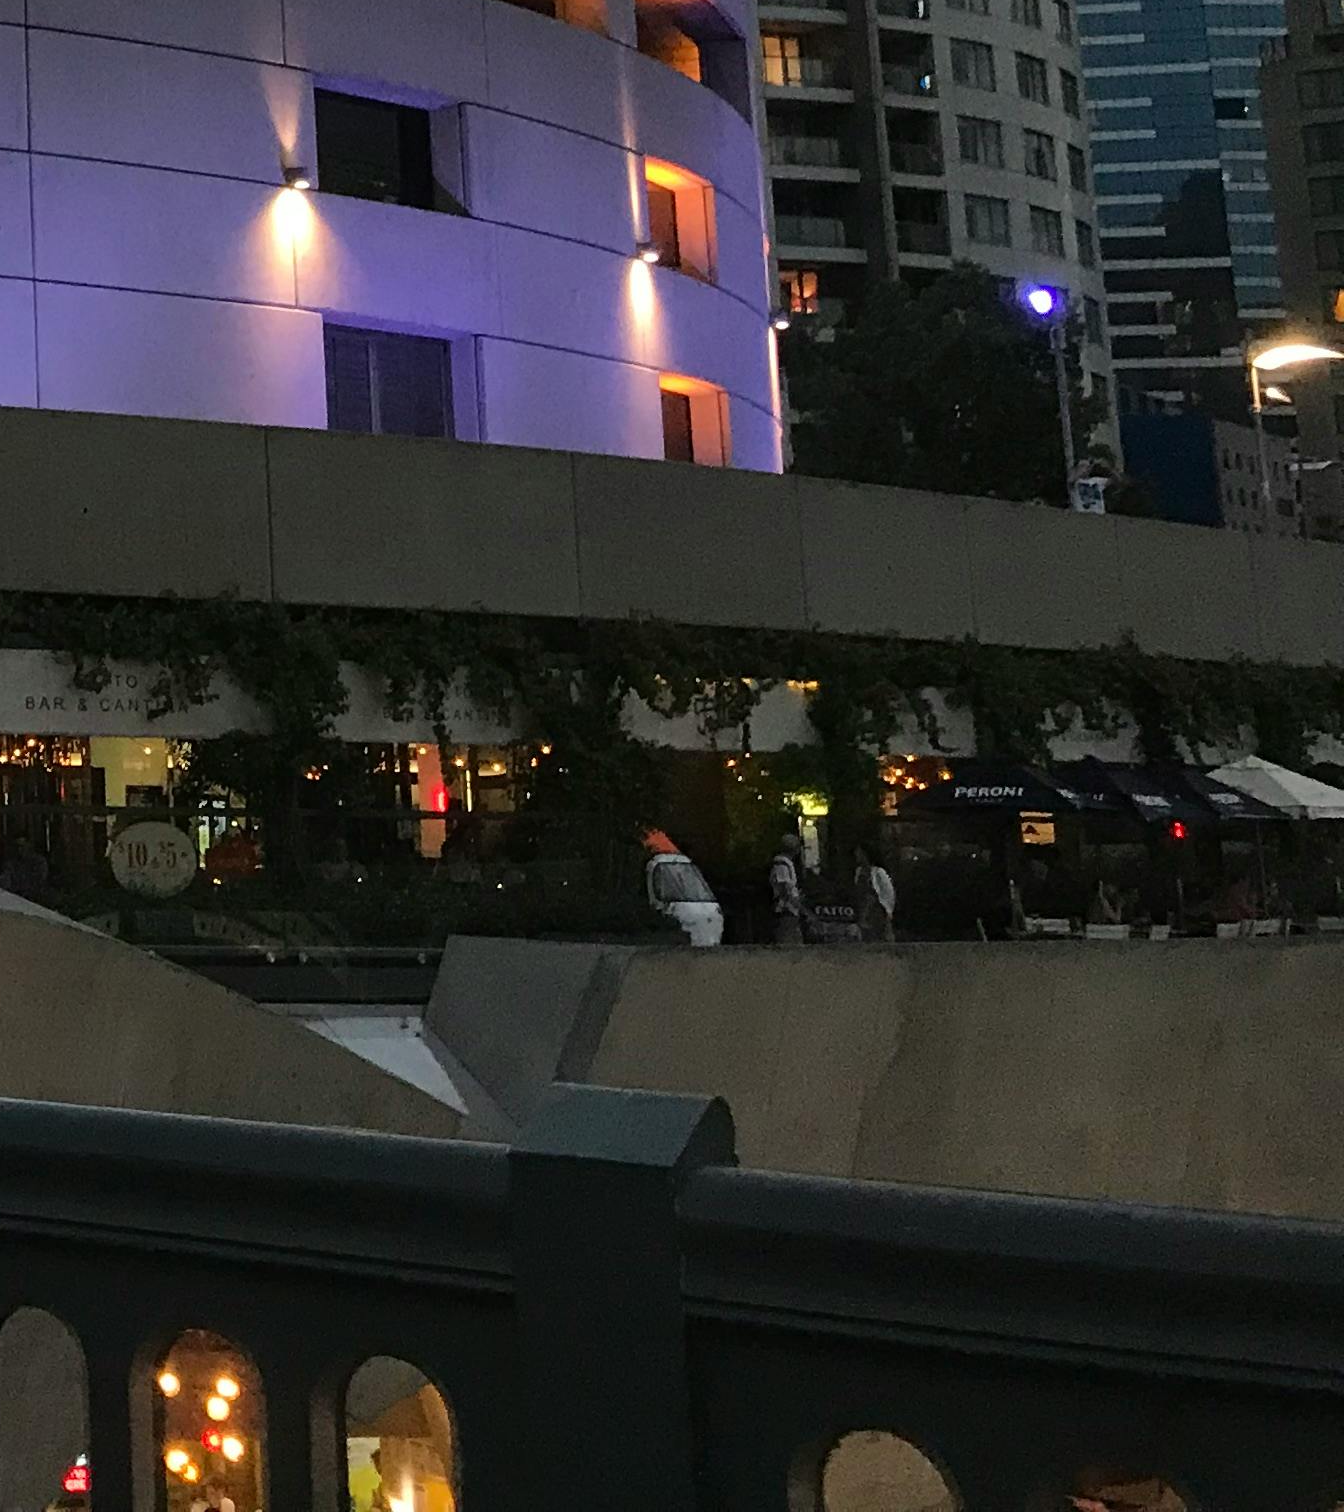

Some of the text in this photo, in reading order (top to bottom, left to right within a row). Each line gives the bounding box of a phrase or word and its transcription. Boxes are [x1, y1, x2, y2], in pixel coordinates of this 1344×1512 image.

[24, 695, 189, 713] BAR & CANTIA
[955, 786, 1024, 798] PERONI
